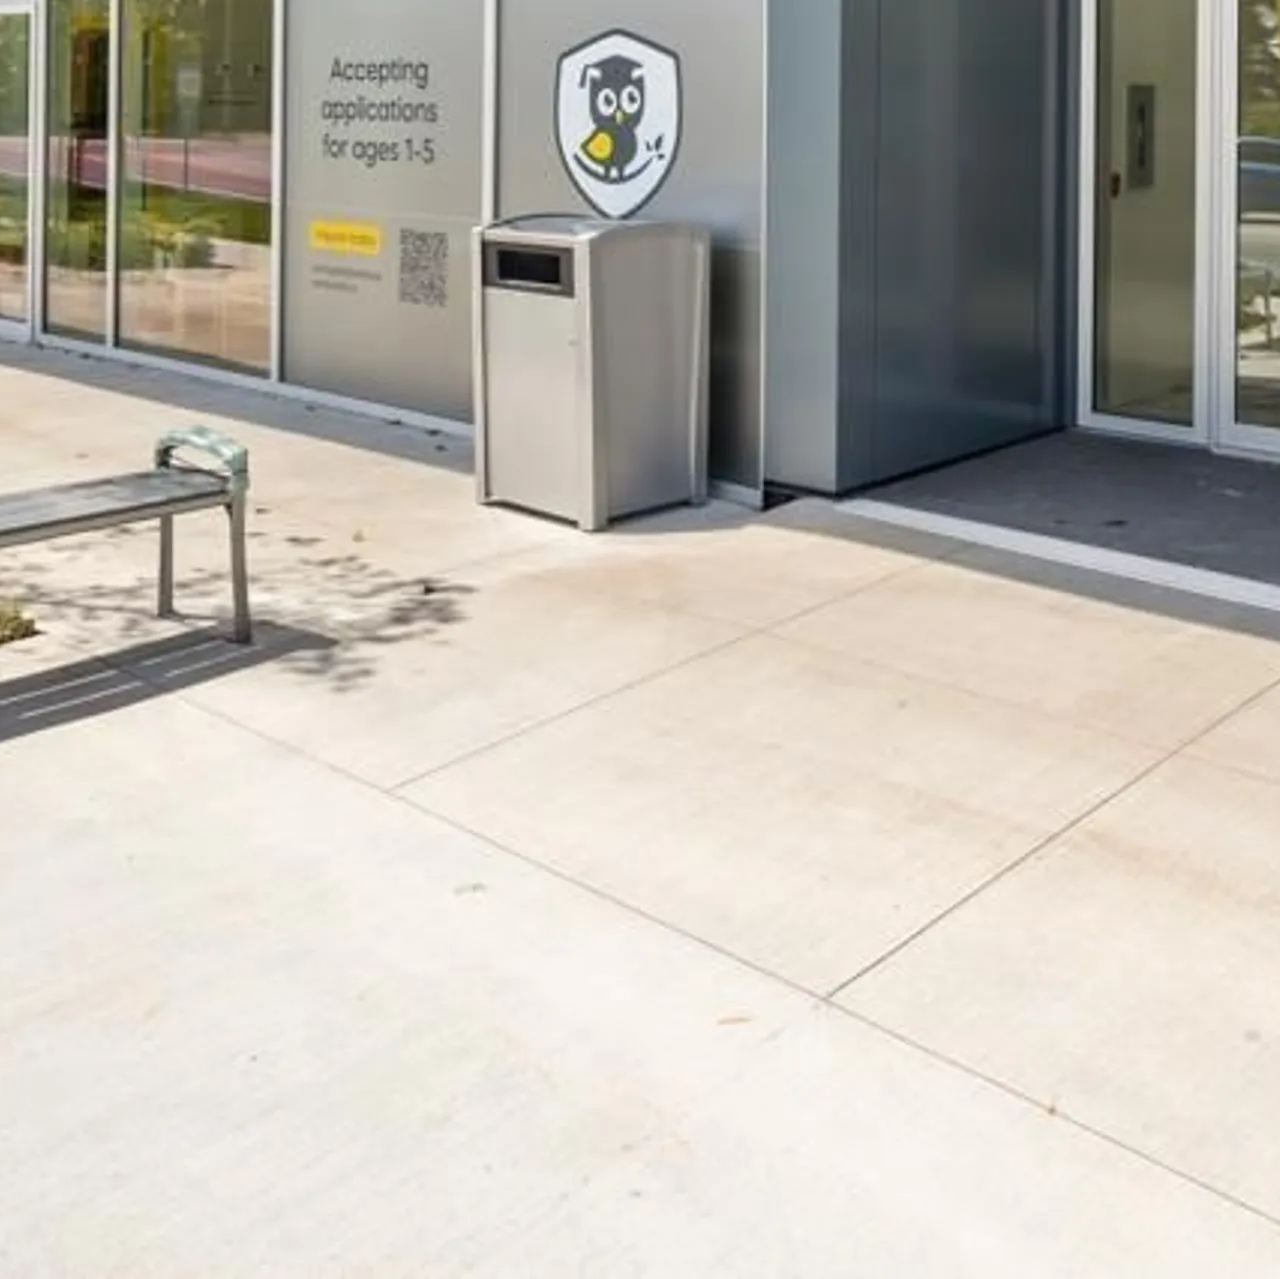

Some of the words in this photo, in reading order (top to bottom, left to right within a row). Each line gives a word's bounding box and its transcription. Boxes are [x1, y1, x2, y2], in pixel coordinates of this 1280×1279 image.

[328, 56, 429, 90] Accepting
[322, 95, 438, 126] applications
[322, 133, 349, 158] for
[351, 141, 400, 168] ages
[404, 138, 435, 164] 1-5
